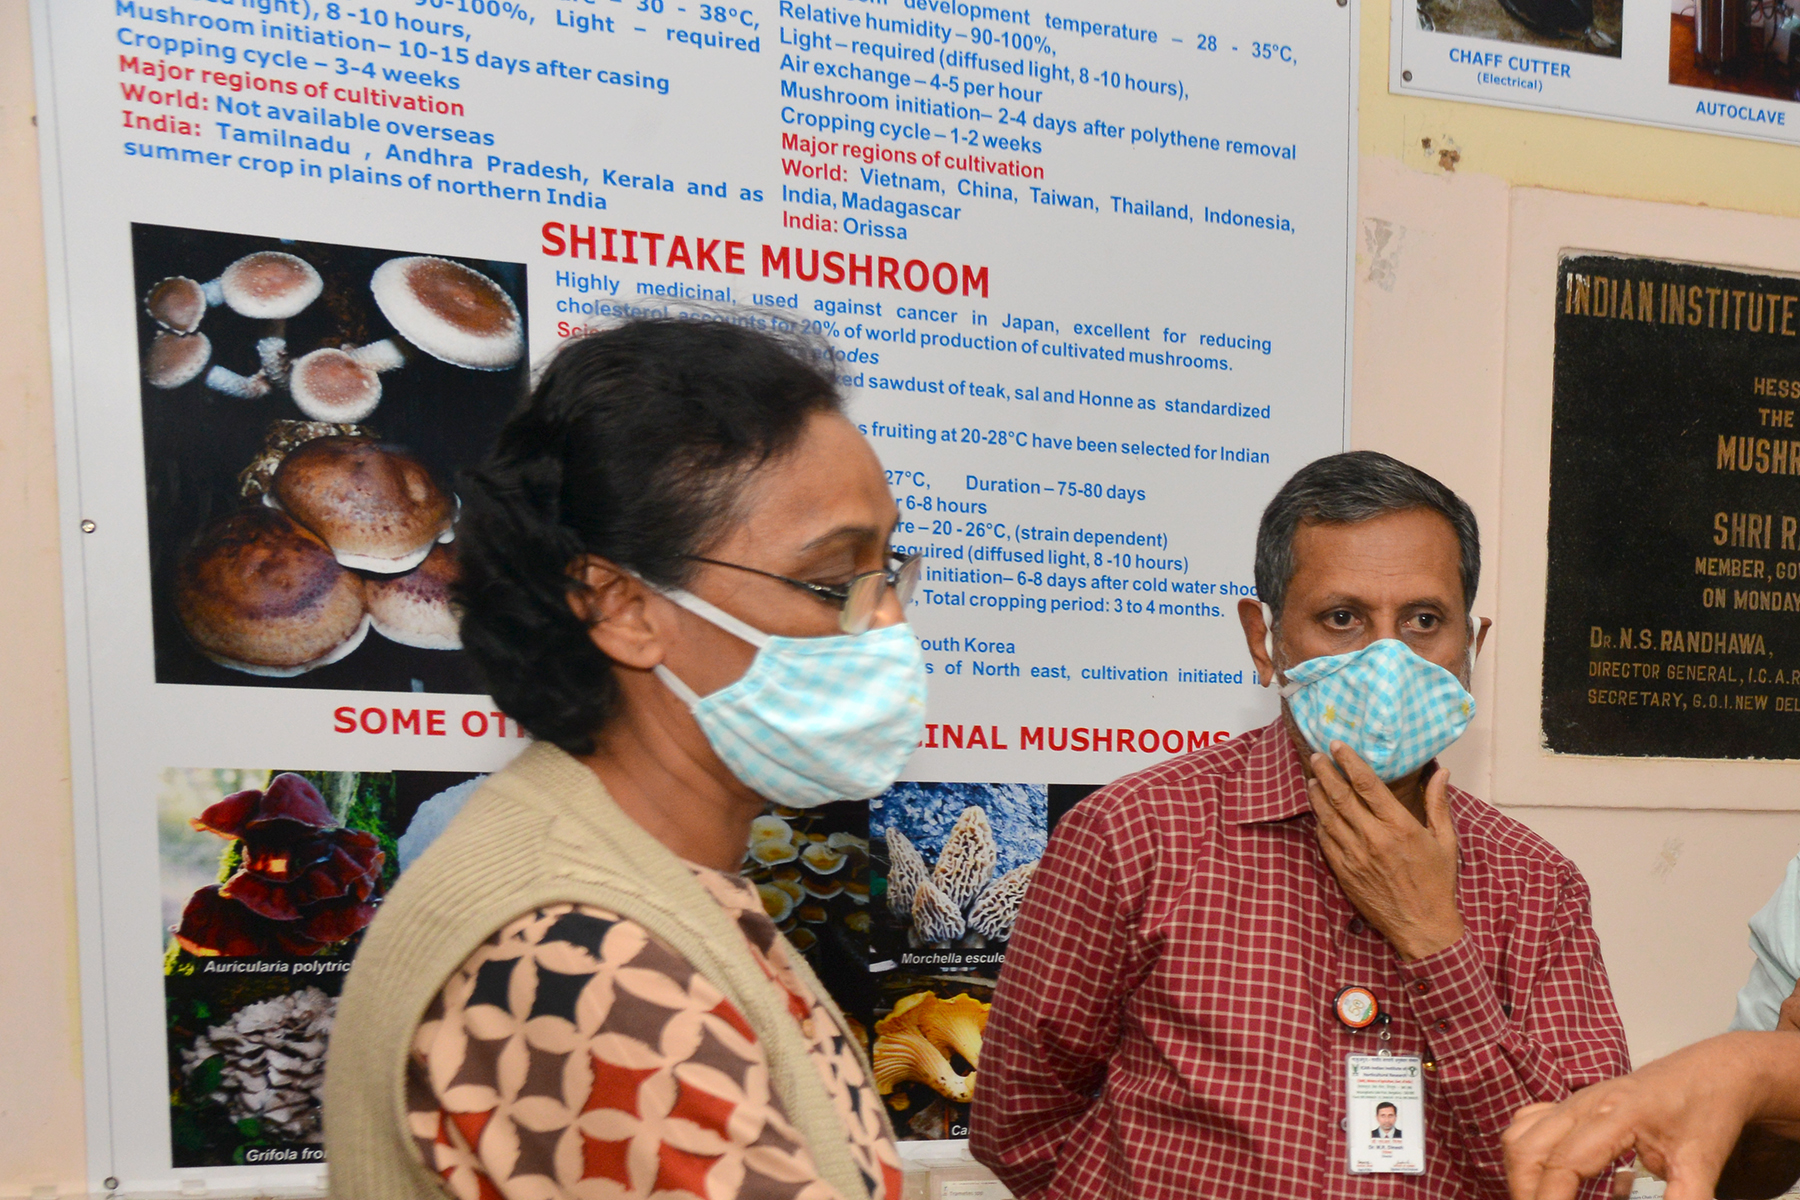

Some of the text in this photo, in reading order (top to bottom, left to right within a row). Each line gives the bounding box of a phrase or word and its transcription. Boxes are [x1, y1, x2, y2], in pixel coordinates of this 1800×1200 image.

[1449, 48, 1571, 79] CHAFF CUTTER
[119, 54, 465, 117] Major regions of cultivation
[1477, 71, 1543, 93] (Electrical)
[120, 82, 496, 147] World: Not available overseas
[780, 79, 1297, 160] Mushroom initiation– 2-4 days after polythene removal
[1696, 100, 1786, 126] AUTOCLAVE
[122, 109, 764, 203] India: Tamilnadu Andhra Pradesh, Kerala and as
[123, 141, 608, 210] summer crop in plains of northern India
[781, 158, 1296, 234] World: Vietnam, China, Taiwan, Thailand, Indonesia,
[782, 184, 962, 220] India, Madagascar
[783, 210, 908, 240] India: Orissa
[541, 221, 989, 299] SHIITAKE MUSHROOM
[555, 270, 1272, 356] Highly medicinal, used against cancer in Japan, excellent for reducing
[1565, 272, 1653, 322] INDIAN
[1660, 283, 1798, 336] INSTITUTE
[1758, 407, 1794, 428] THE
[1712, 511, 1771, 550] SHRI
[926, 565, 1258, 597] initiation– 6-8 days after cold water shoc
[922, 588, 1225, 618] Total cropping period: 3 to 4 months.
[1702, 588, 1726, 609] ON
[1660, 629, 1774, 658] RANDHAWA,
[1588, 660, 1659, 680] DIRECTOR
[1666, 664, 1744, 686] GENERAL,
[1587, 688, 1688, 711] SECRETARY,
[1735, 695, 1767, 711] NEW
[333, 706, 447, 736] SOME
[204, 959, 289, 975] Auricularia
[901, 952, 1006, 965] Morchella escule
[245, 1147, 298, 1163] Grifola
